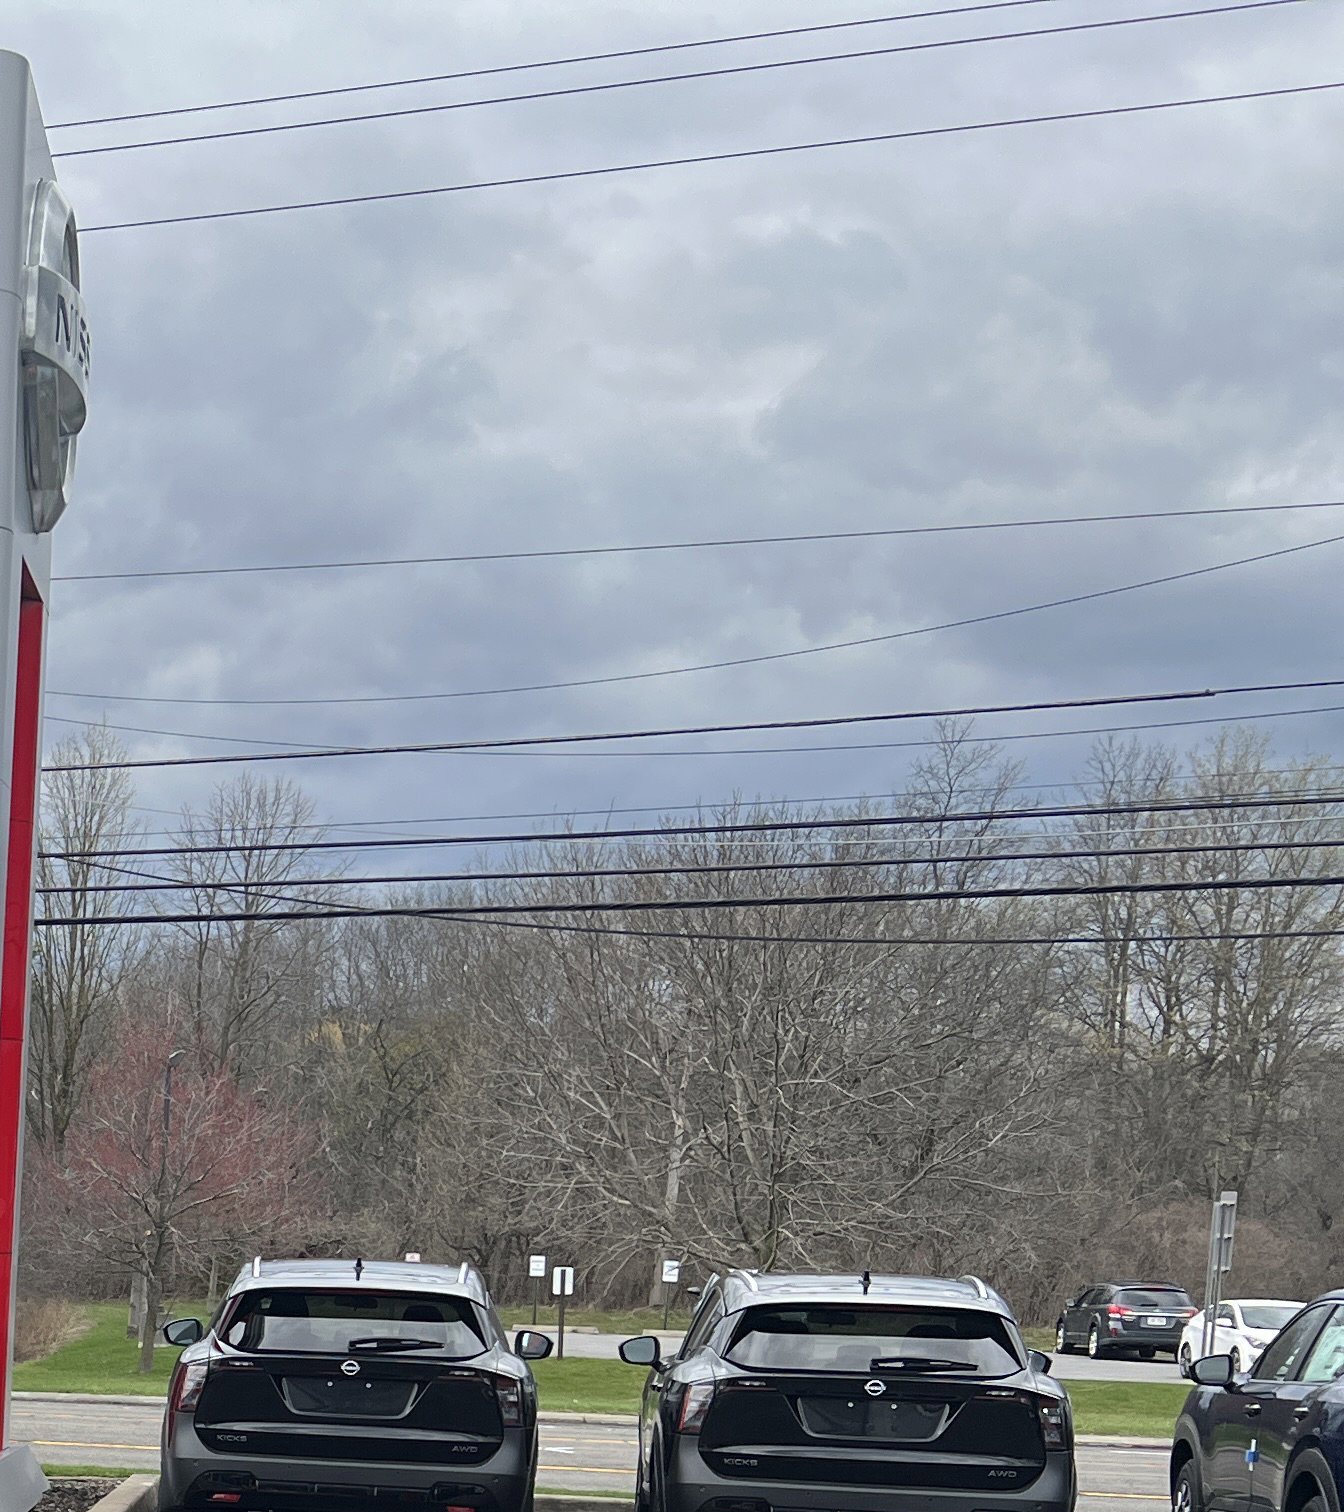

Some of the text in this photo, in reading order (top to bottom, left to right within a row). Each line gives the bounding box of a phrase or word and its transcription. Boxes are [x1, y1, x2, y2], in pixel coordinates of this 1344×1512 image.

[216, 1434, 248, 1442] KICKS
[451, 1445, 478, 1453] AWD
[723, 1457, 758, 1467] KICKS
[987, 1469, 1017, 1478] AWD
